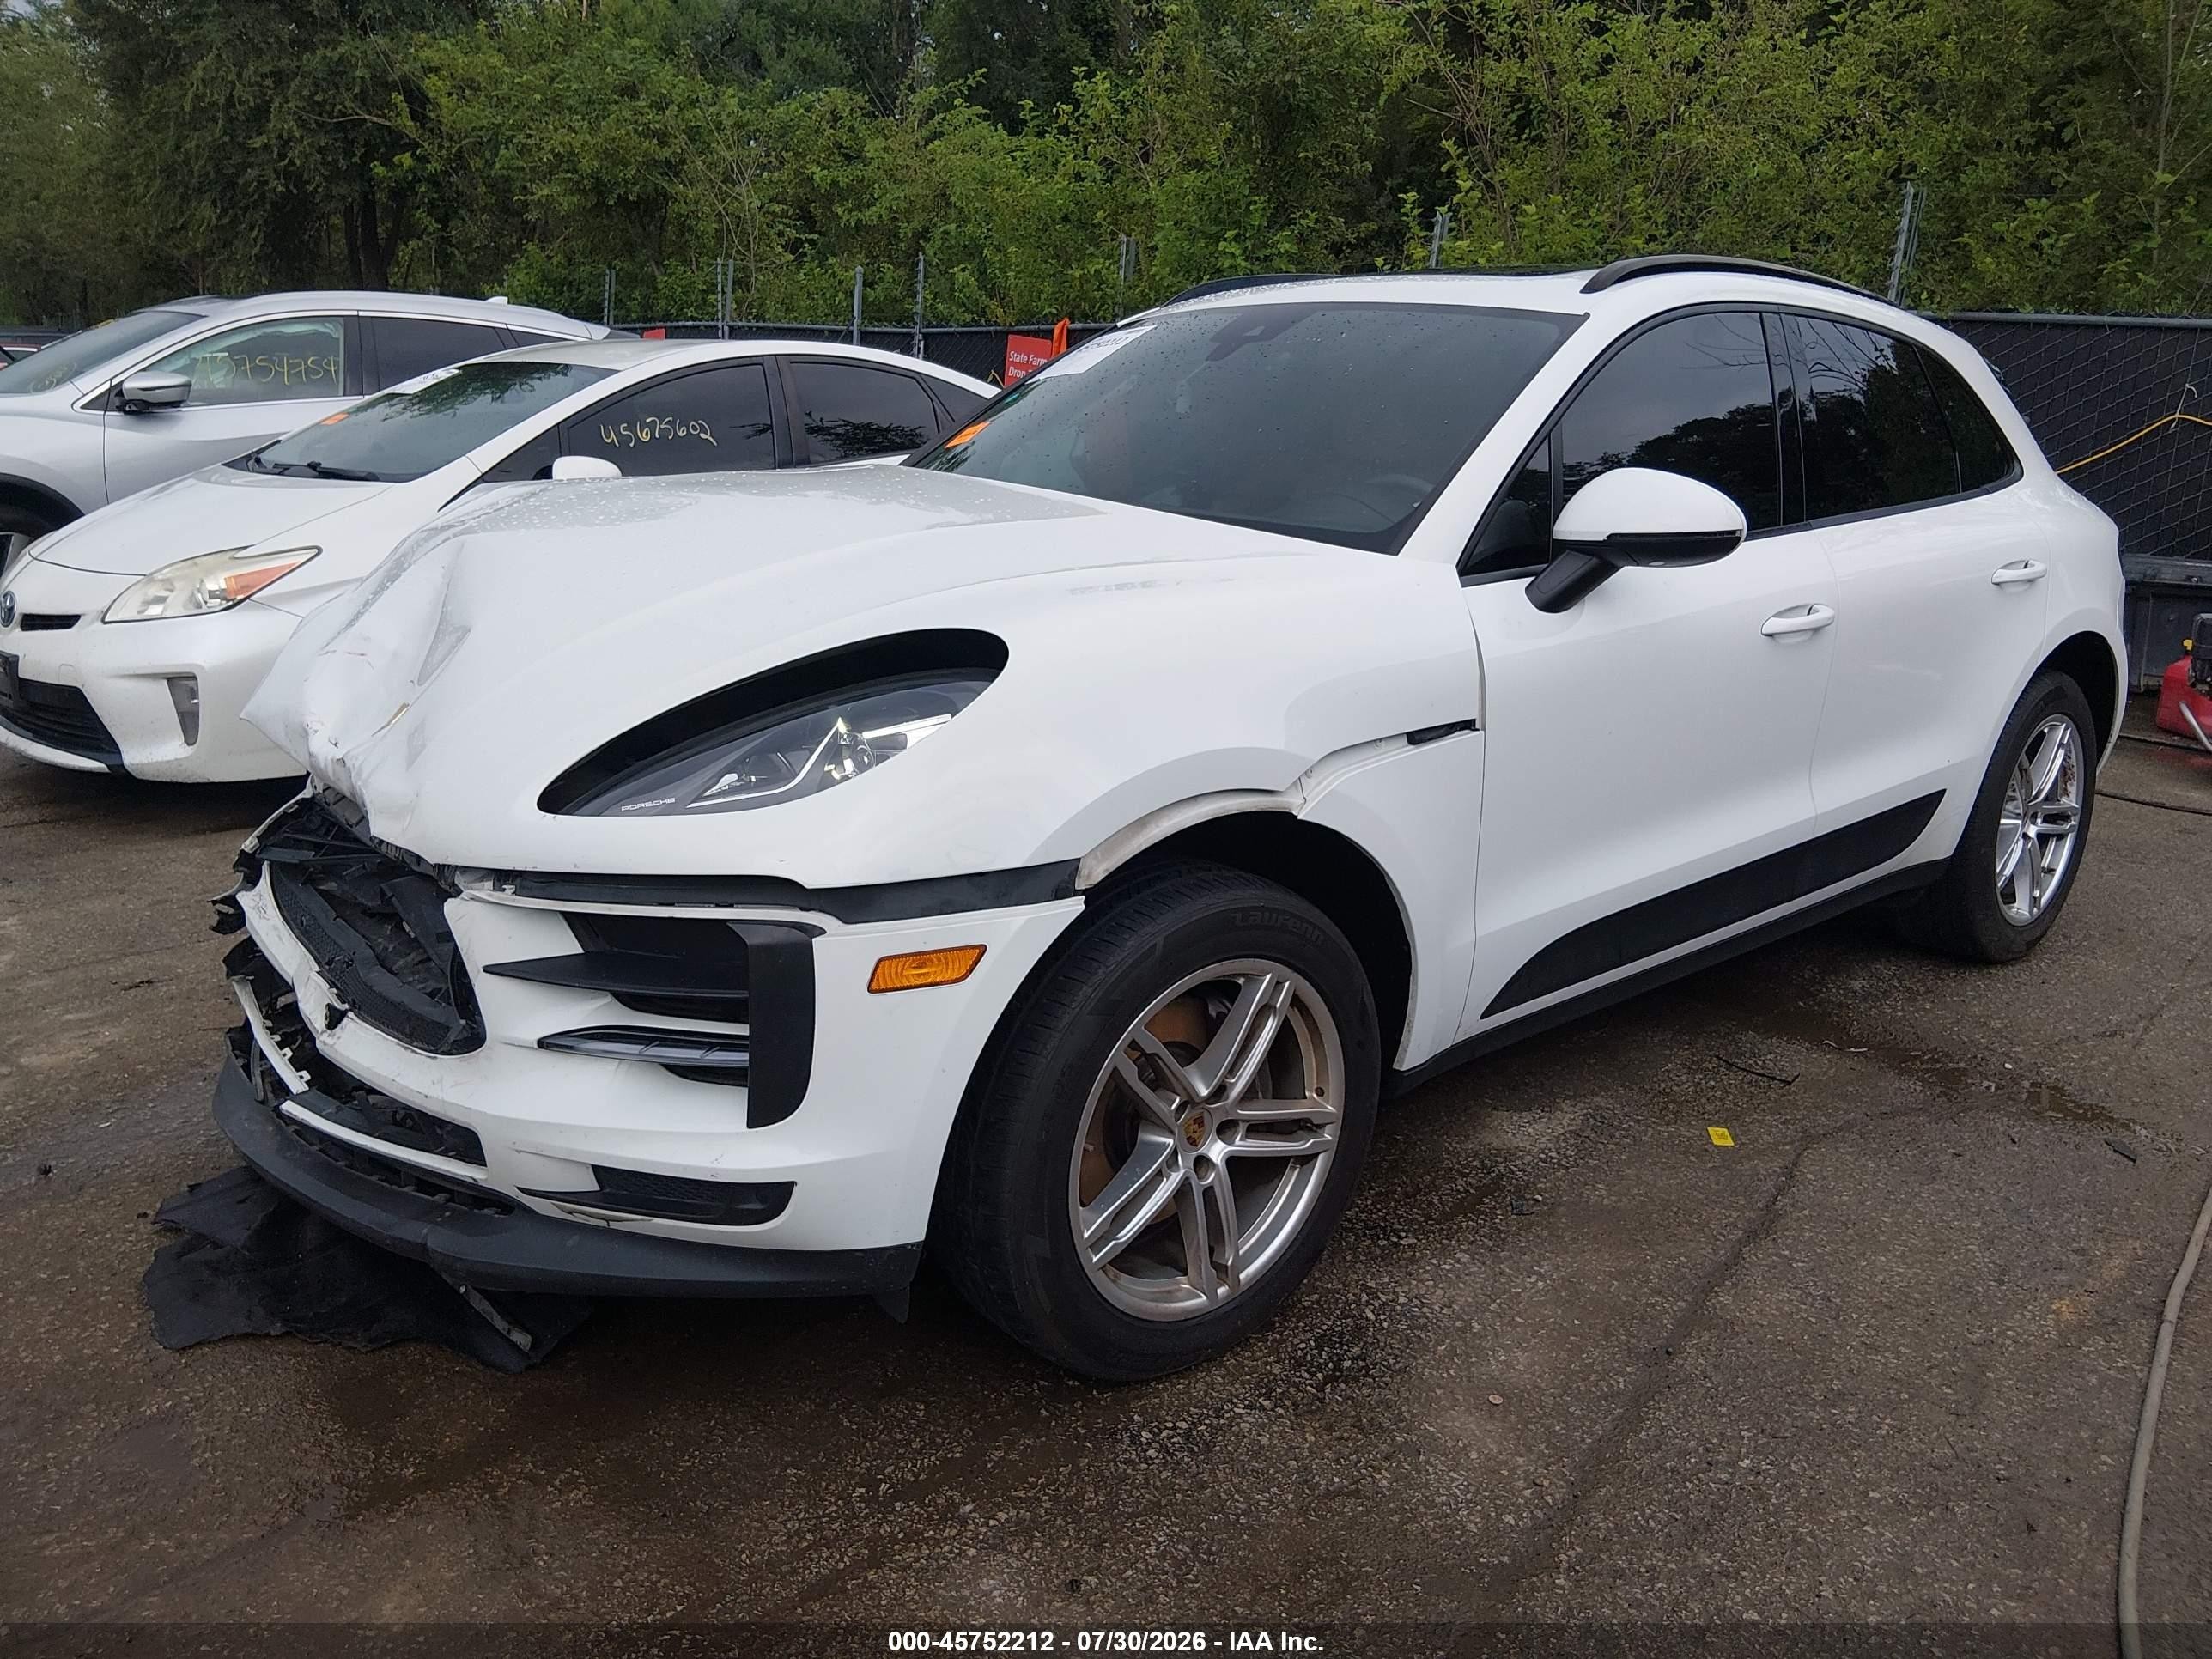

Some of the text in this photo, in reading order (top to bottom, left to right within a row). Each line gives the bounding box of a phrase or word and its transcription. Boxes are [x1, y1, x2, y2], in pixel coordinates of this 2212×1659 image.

[1009, 350, 1028, 363] State
[599, 416, 718, 447] 45675602
[621, 797, 676, 812] PORSCHE
